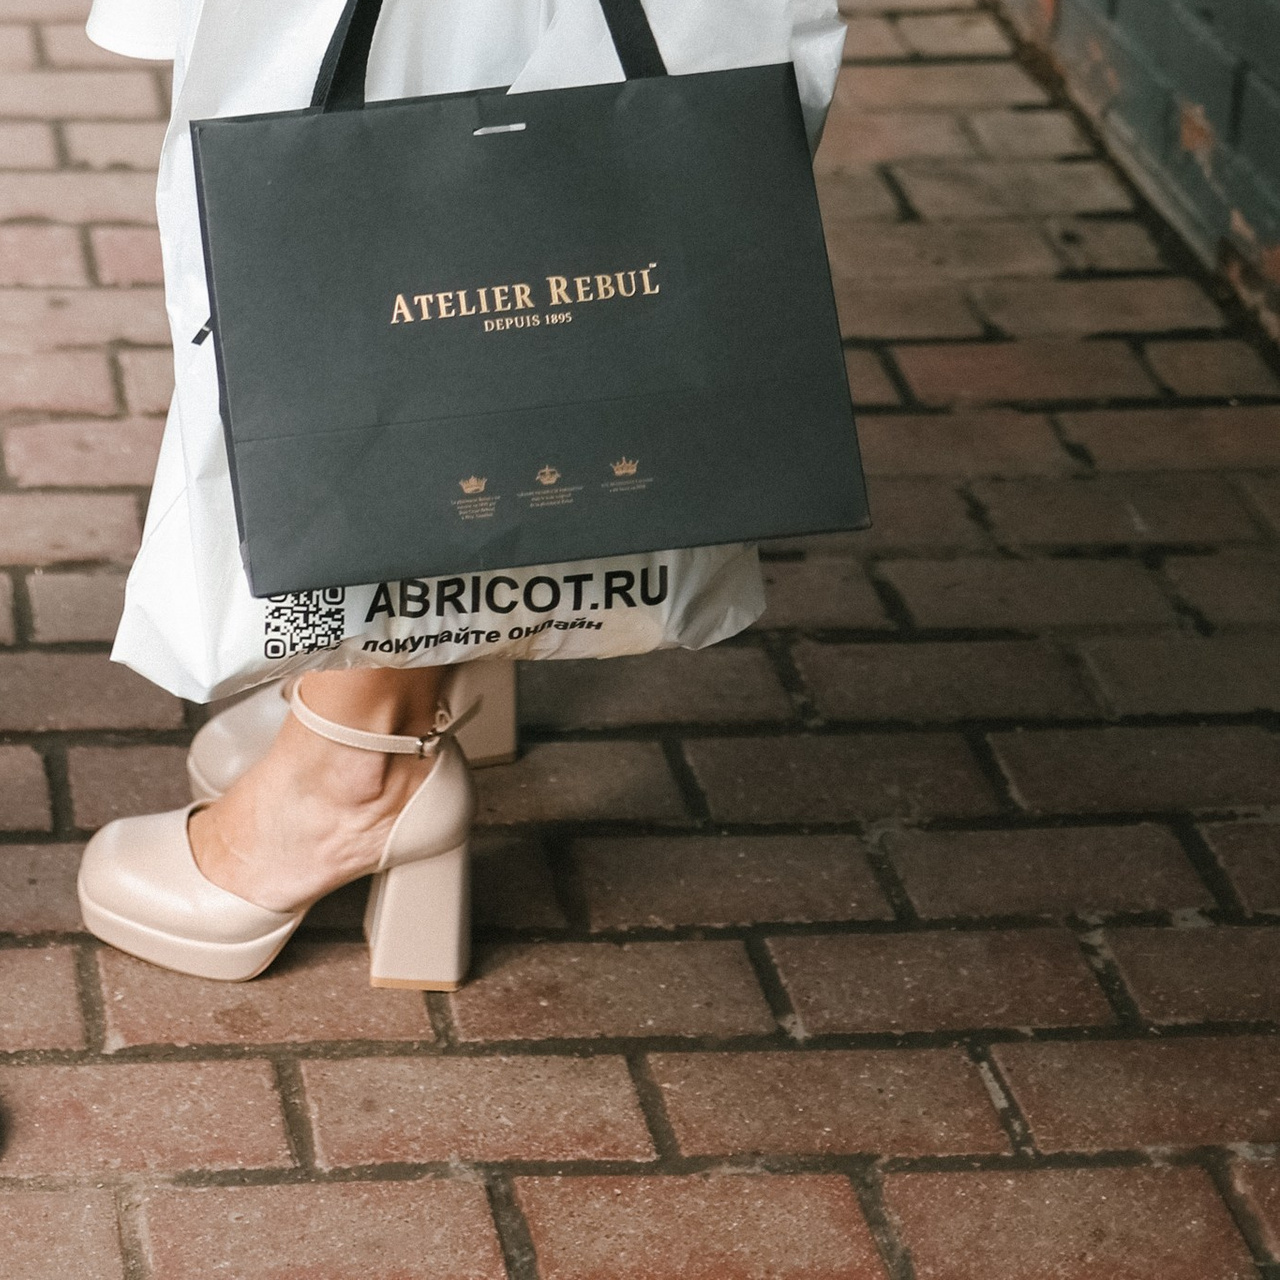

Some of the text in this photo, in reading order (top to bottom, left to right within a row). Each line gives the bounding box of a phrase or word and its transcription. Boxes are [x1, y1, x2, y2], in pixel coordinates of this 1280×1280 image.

[390, 283, 535, 325] ATELIER
[484, 312, 573, 332] DEPUIS 1895
[364, 565, 669, 623] ABRICOT.RU
[361, 617, 604, 654] покупайте онлайн
